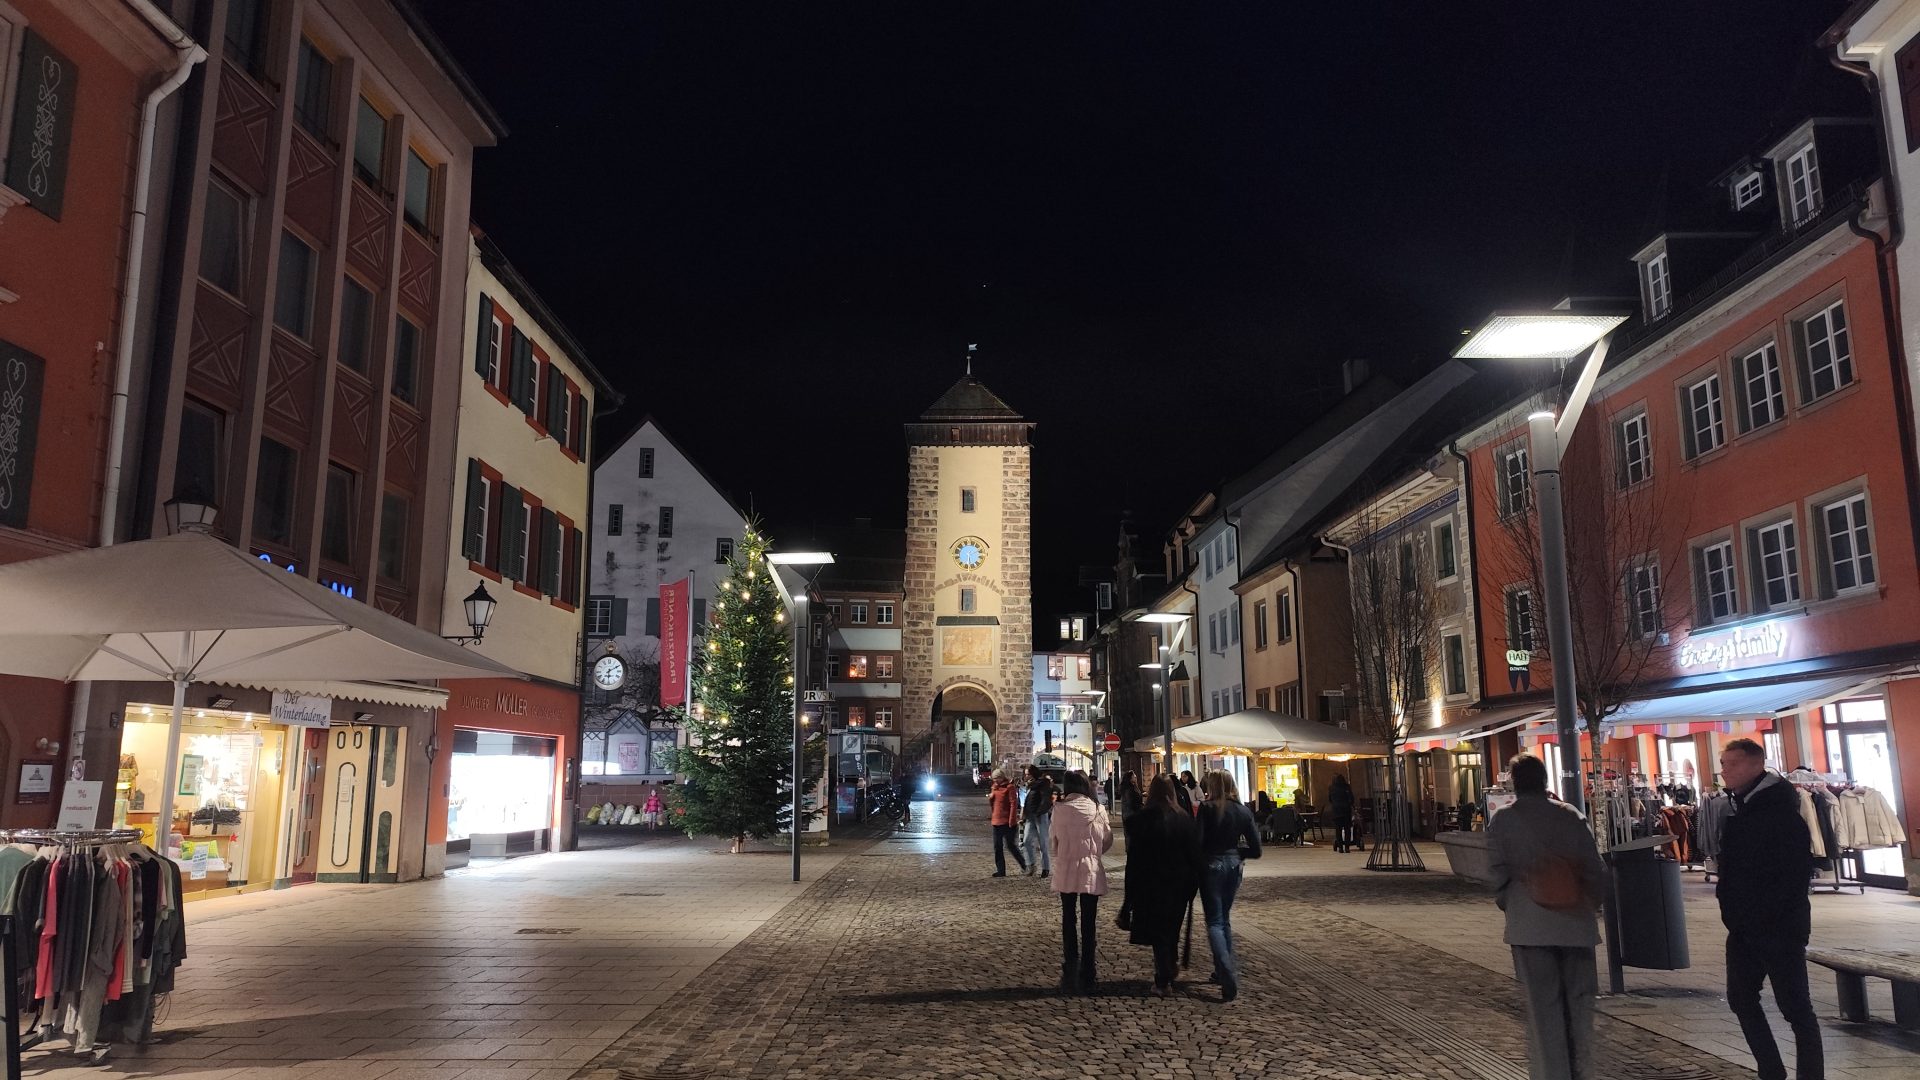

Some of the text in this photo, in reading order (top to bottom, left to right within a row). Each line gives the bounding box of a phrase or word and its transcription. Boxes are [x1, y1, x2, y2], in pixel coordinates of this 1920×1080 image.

[1733, 622, 1787, 658] family
[283, 690, 300, 704] Der
[495, 691, 528, 717] MÜLLER
[273, 704, 321, 722] Winterladen
